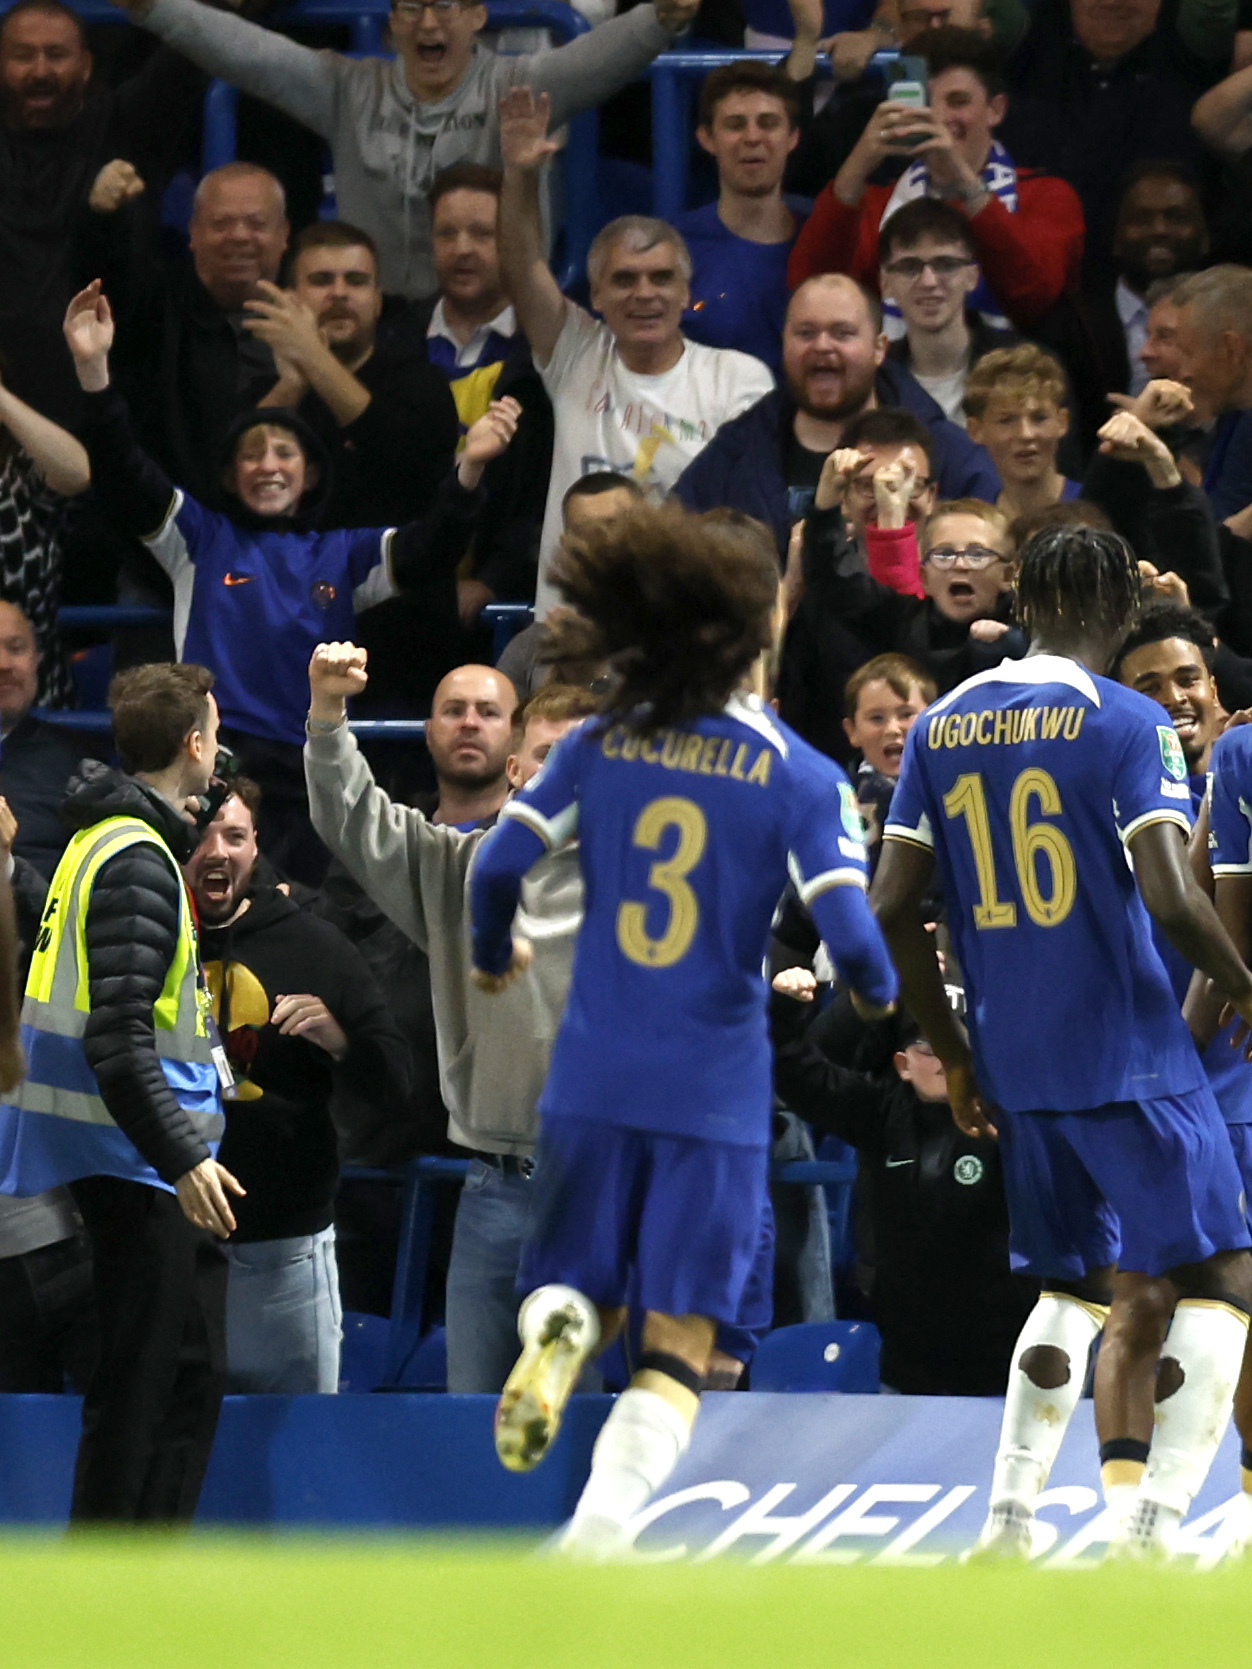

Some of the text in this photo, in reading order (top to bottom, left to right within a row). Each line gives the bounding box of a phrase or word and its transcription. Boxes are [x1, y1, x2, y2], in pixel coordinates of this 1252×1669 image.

[928, 706, 1085, 749] UGOCHUKWU
[616, 796, 708, 968] 3
[942, 767, 1077, 929] 16
